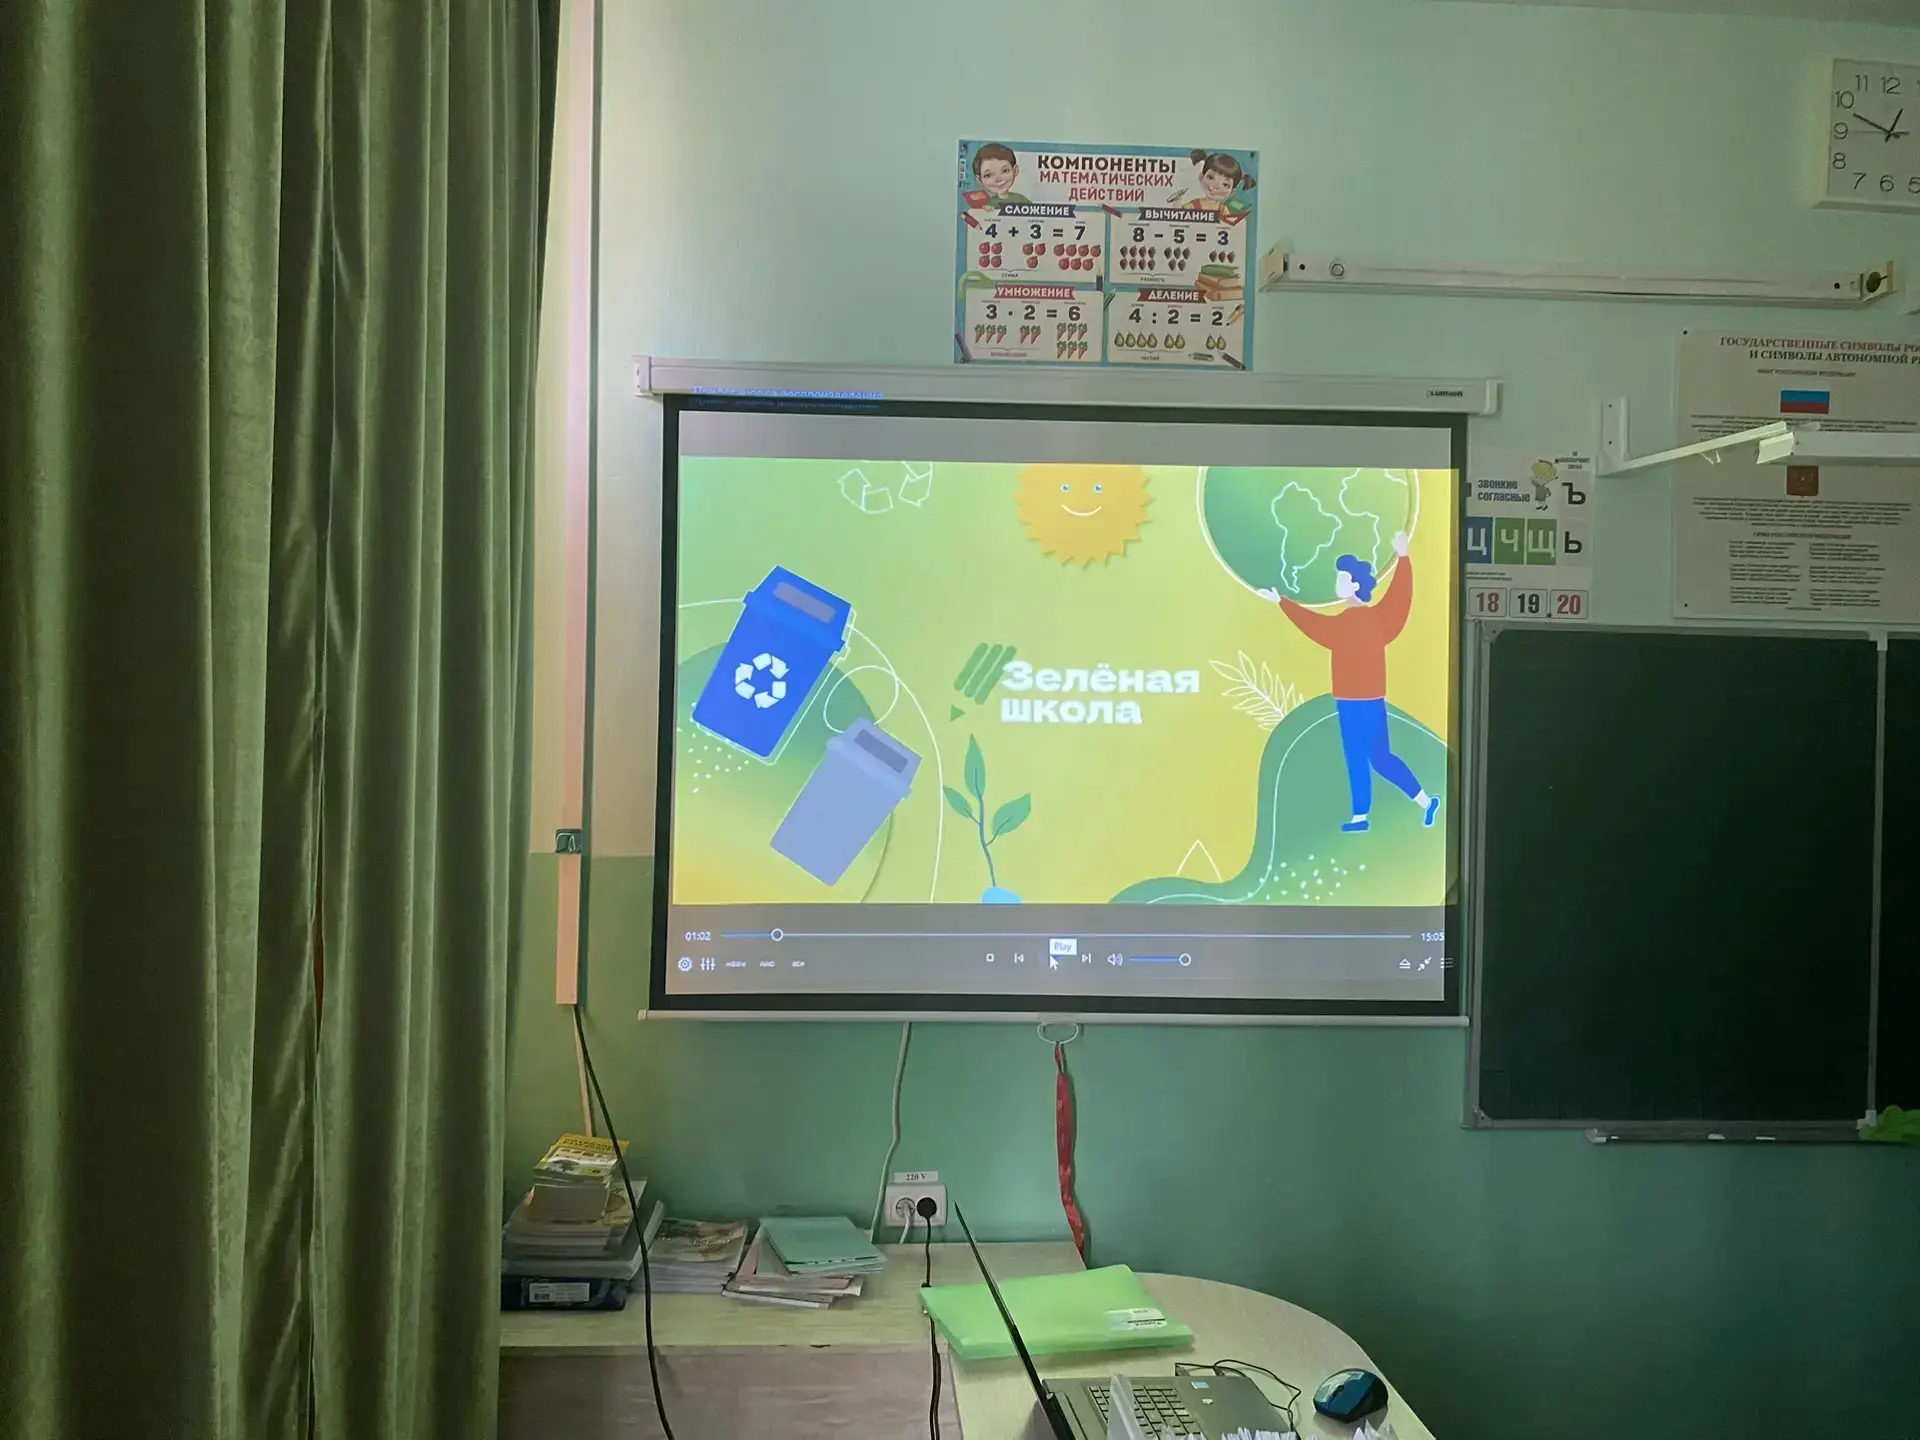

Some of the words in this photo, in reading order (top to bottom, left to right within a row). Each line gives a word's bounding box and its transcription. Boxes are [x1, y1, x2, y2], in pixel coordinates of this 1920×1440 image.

[1855, 74, 1868, 92] 11
[1880, 76, 1901, 94] 12
[1834, 90, 1855, 109] 10
[1833, 122, 1849, 140] 9
[1038, 155, 1176, 173] КОМПОНЕНТЫ
[1832, 152, 1846, 169] 8
[1040, 171, 1173, 187] МАТЕМАТИЧЕСКИХ
[1852, 172, 1866, 190] 7
[1879, 174, 1894, 192] 6
[1908, 176, 1920, 194] 5
[1069, 186, 1145, 202] ДЕЙСТВИЙ
[1004, 205, 1070, 216] СЛОЖЕНИЕ
[1145, 209, 1215, 221] ВЫЧИТАНИЕ
[985, 223, 998, 238] 4
[1029, 224, 1042, 239] 3
[1074, 225, 1086, 241] 7
[1132, 227, 1145, 242] 8
[1173, 229, 1185, 244] 5
[1217, 230, 1229, 246] 3
[996, 286, 1071, 298] УМНОЖЕНИЕ
[1148, 289, 1200, 301] ДЕЛЕНИЕ
[985, 304, 998, 319] 3
[1023, 305, 1036, 320] 2
[1068, 306, 1081, 321] 6
[1128, 308, 1142, 323] 4
[1167, 309, 1179, 325] 2
[1211, 311, 1223, 326] 2
[1720, 336, 1839, 350] ГОСУДАРСТВЕННЫЕ
[1840, 340, 1901, 352] СИМВОЛЫ
[1749, 350, 1758, 359] И
[1761, 350, 1823, 361] СИМВОЛЫ
[1825, 352, 1909, 364] АВТОНОМНОЙ
[1561, 482, 1587, 505] Ъ
[1467, 527, 1487, 556] Ц
[1500, 528, 1519, 552] Ч
[1527, 529, 1556, 559] Щ
[1564, 531, 1583, 554] Ь
[1476, 592, 1500, 614] 18
[1517, 593, 1540, 614] 19
[1557, 594, 1582, 615] 20
[1001, 659, 1200, 694] Зелёная
[1001, 698, 1143, 724] школа
[685, 931, 711, 941] 01:02
[1421, 932, 1445, 942] 15:05
[1054, 942, 1072, 952] Play
[906, 1173, 919, 1181] 220
[920, 1172, 927, 1180] V
